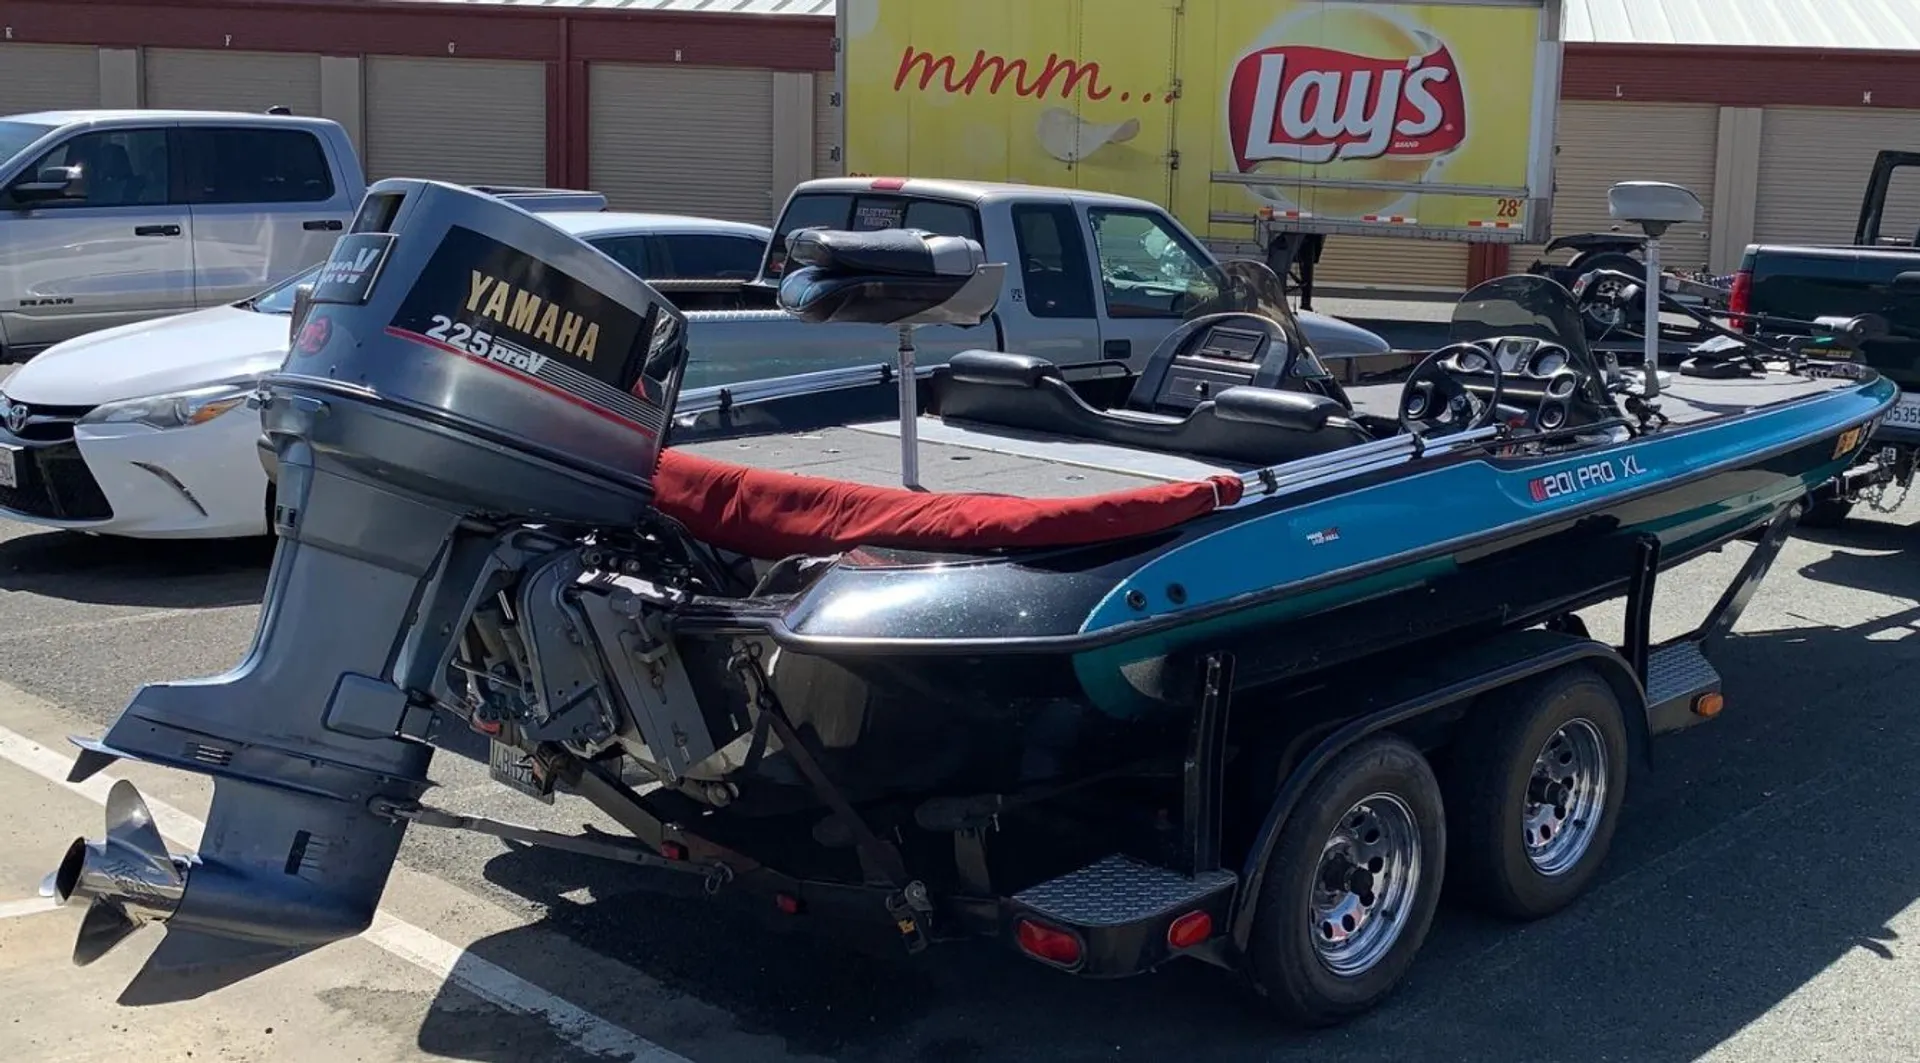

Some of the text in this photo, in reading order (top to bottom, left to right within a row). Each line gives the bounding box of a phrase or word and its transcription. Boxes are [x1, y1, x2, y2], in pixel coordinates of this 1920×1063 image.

[1244, 55, 1450, 164] Lay's
[1616, 85, 1622, 97] L
[425, 315, 492, 357] 225
[466, 270, 600, 362] YAMAHA
[1577, 461, 1615, 489] PRO
[1619, 455, 1647, 477] XL
